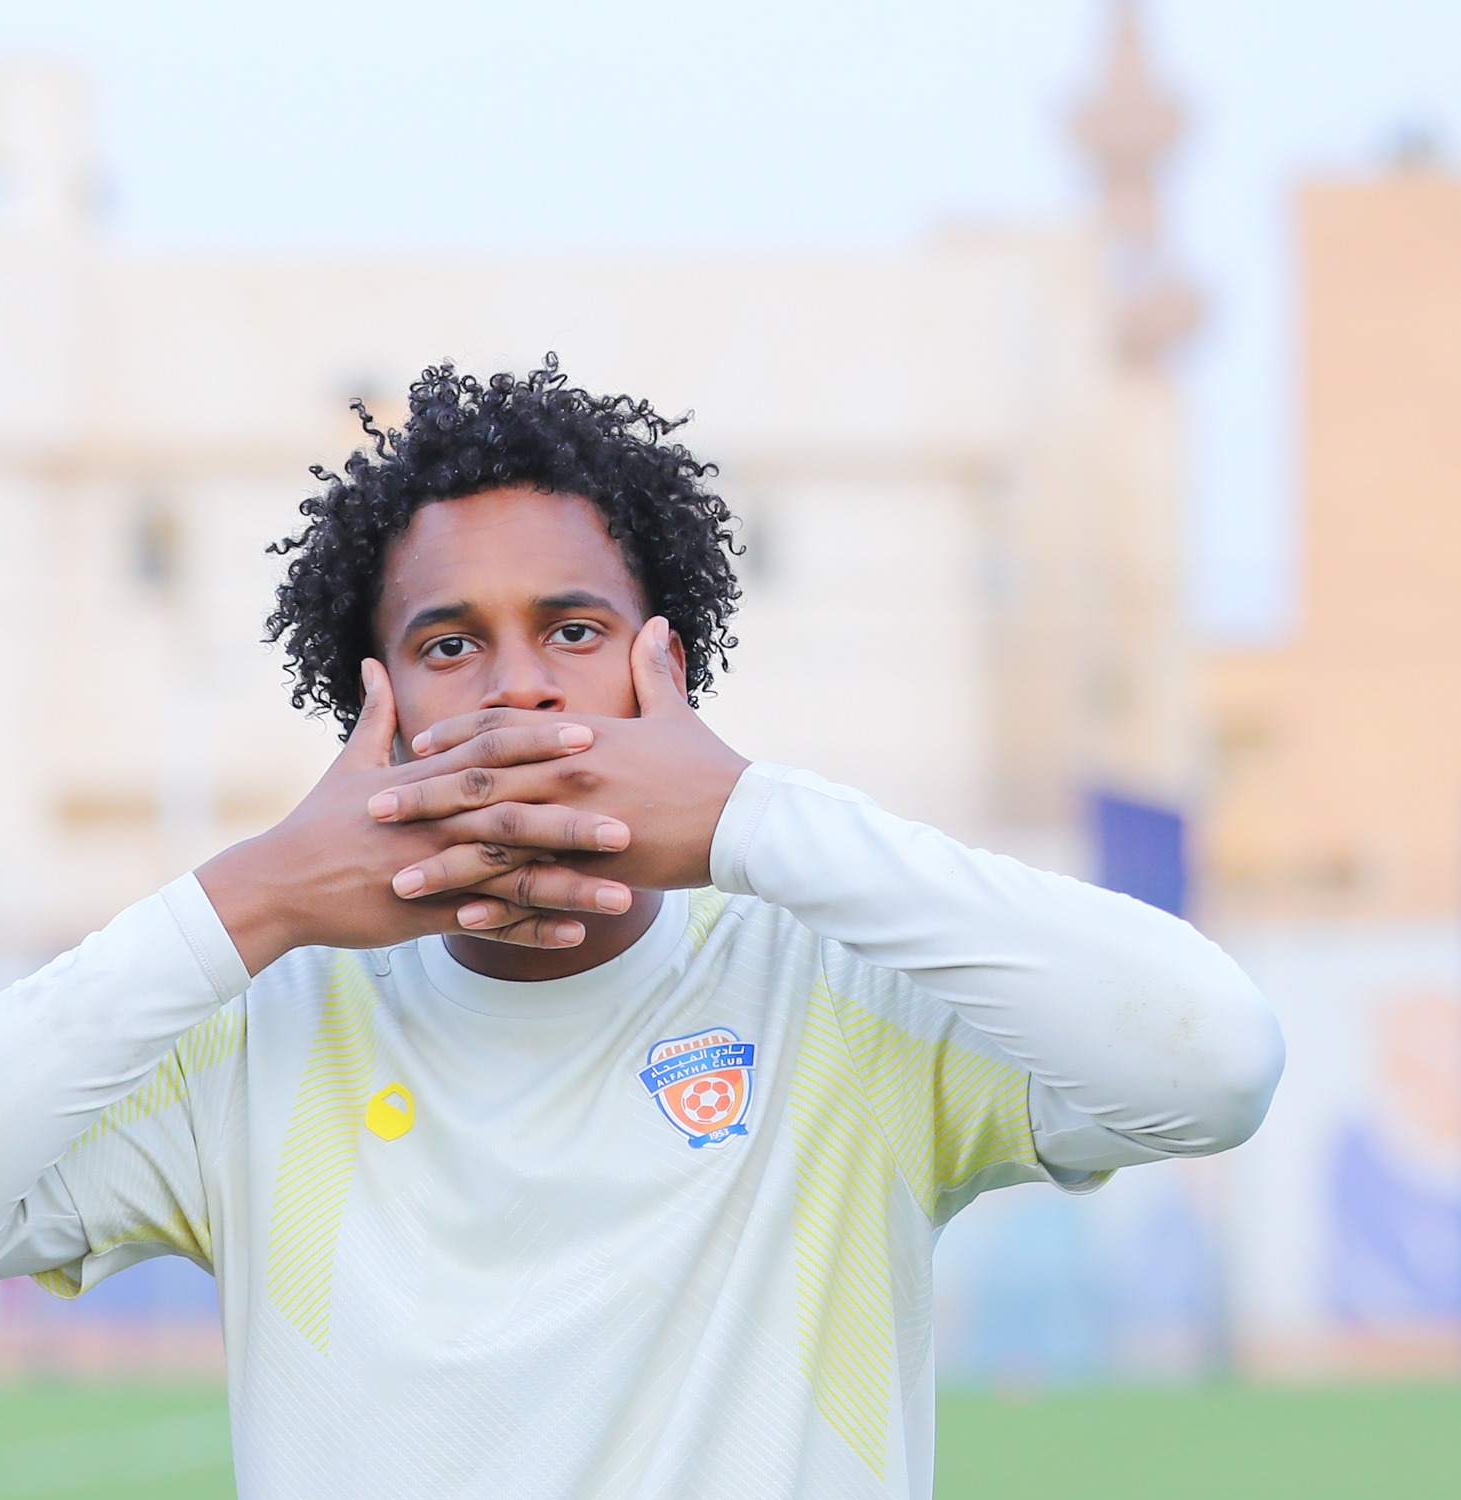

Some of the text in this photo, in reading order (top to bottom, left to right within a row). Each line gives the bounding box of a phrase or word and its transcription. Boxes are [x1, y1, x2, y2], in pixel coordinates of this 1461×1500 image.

[656, 1057, 743, 1088] ALFAYHA CLUB
[709, 1128, 730, 1140] 1953
